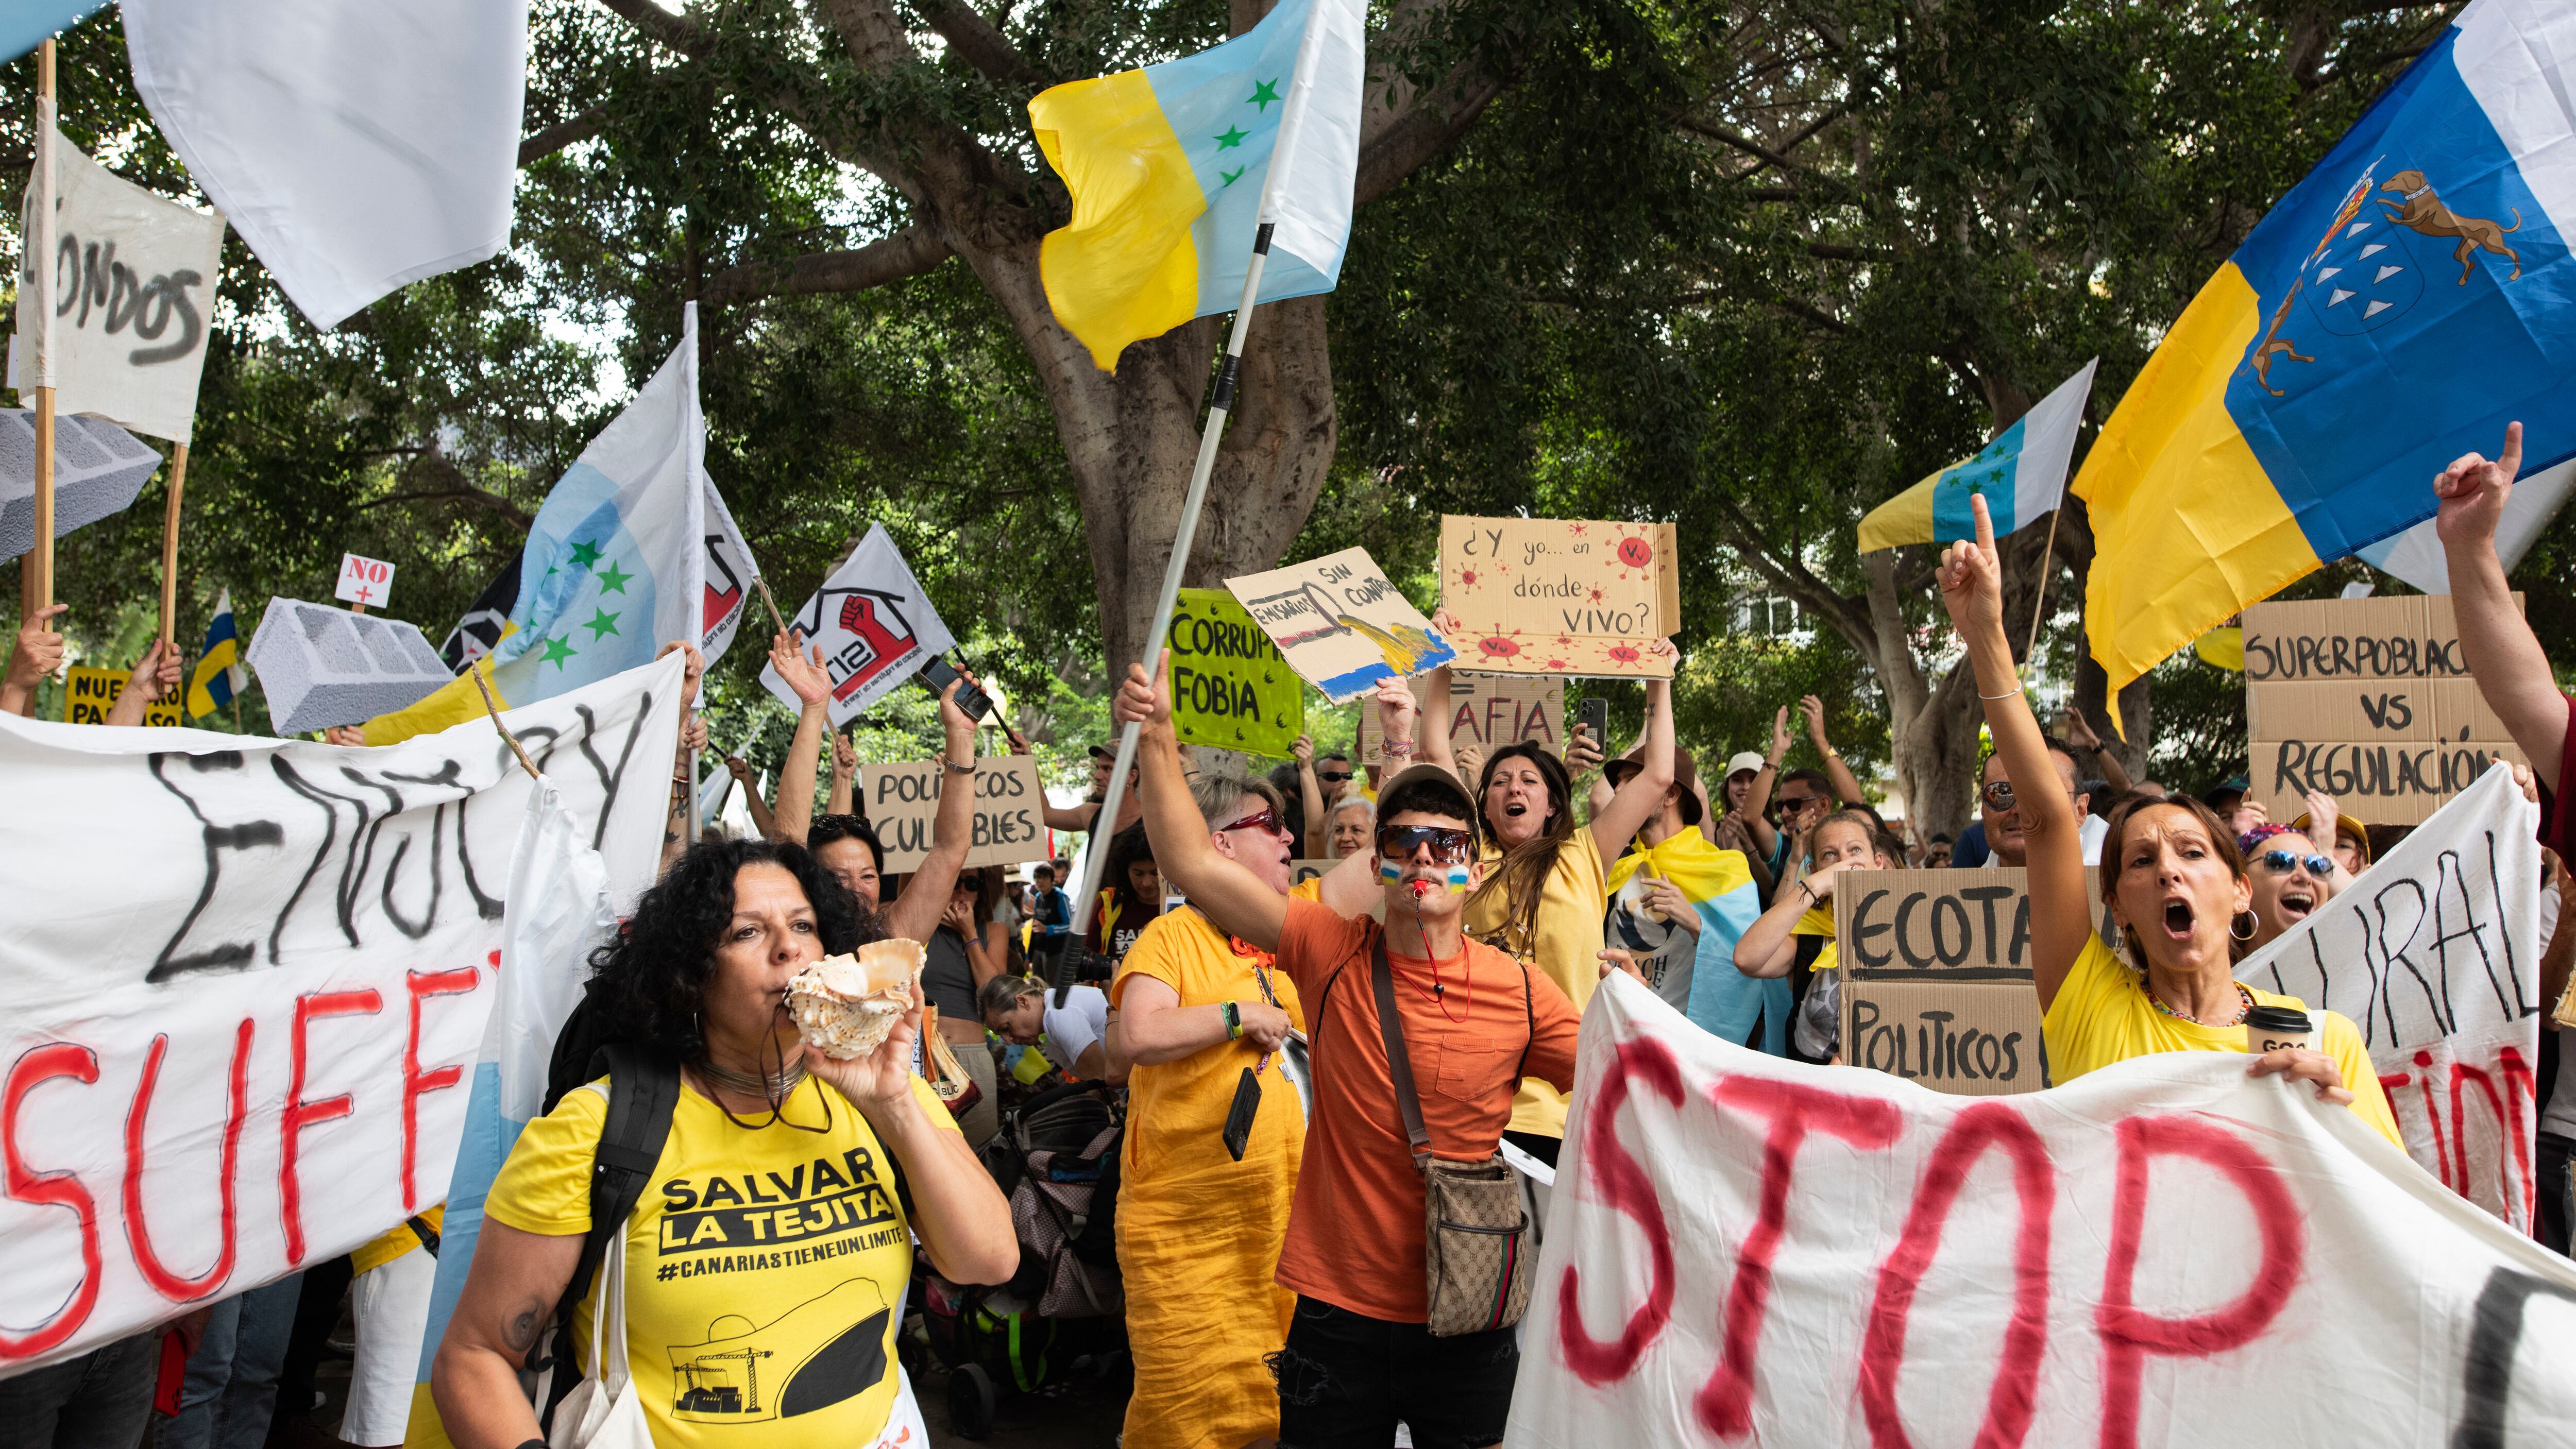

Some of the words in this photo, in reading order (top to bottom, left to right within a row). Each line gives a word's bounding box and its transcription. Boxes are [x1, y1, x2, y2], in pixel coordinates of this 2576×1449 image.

[24, 196, 202, 367] ONDOS
[347, 557, 387, 584] NO
[1573, 542, 1589, 554] en
[1318, 564, 1353, 584] SIN
[1514, 573, 1582, 598] dónde
[1252, 597, 1317, 625] EMISARIOS
[1563, 603, 1649, 634] VIVO?
[1170, 613, 1286, 663] CORRUP
[2245, 634, 2471, 680] SUPERPOBLAC
[76, 676, 179, 707] NUEO
[2360, 693, 2412, 730] VS
[1415, 697, 1554, 745] AFIA
[878, 767, 1025, 804] POLÍCOS
[2269, 830, 2538, 1049] URAL
[1851, 999, 2022, 1081] POLITICOS
[0, 950, 501, 1360] SUFF
[662, 1147, 878, 1212] SALVAR
[662, 1216, 727, 1249] LA
[743, 1188, 894, 1240] TEJITA
[1559, 1034, 2306, 1449] STOP
[656, 1226, 903, 1282] #CANARIASTIENEUNLIMITE
